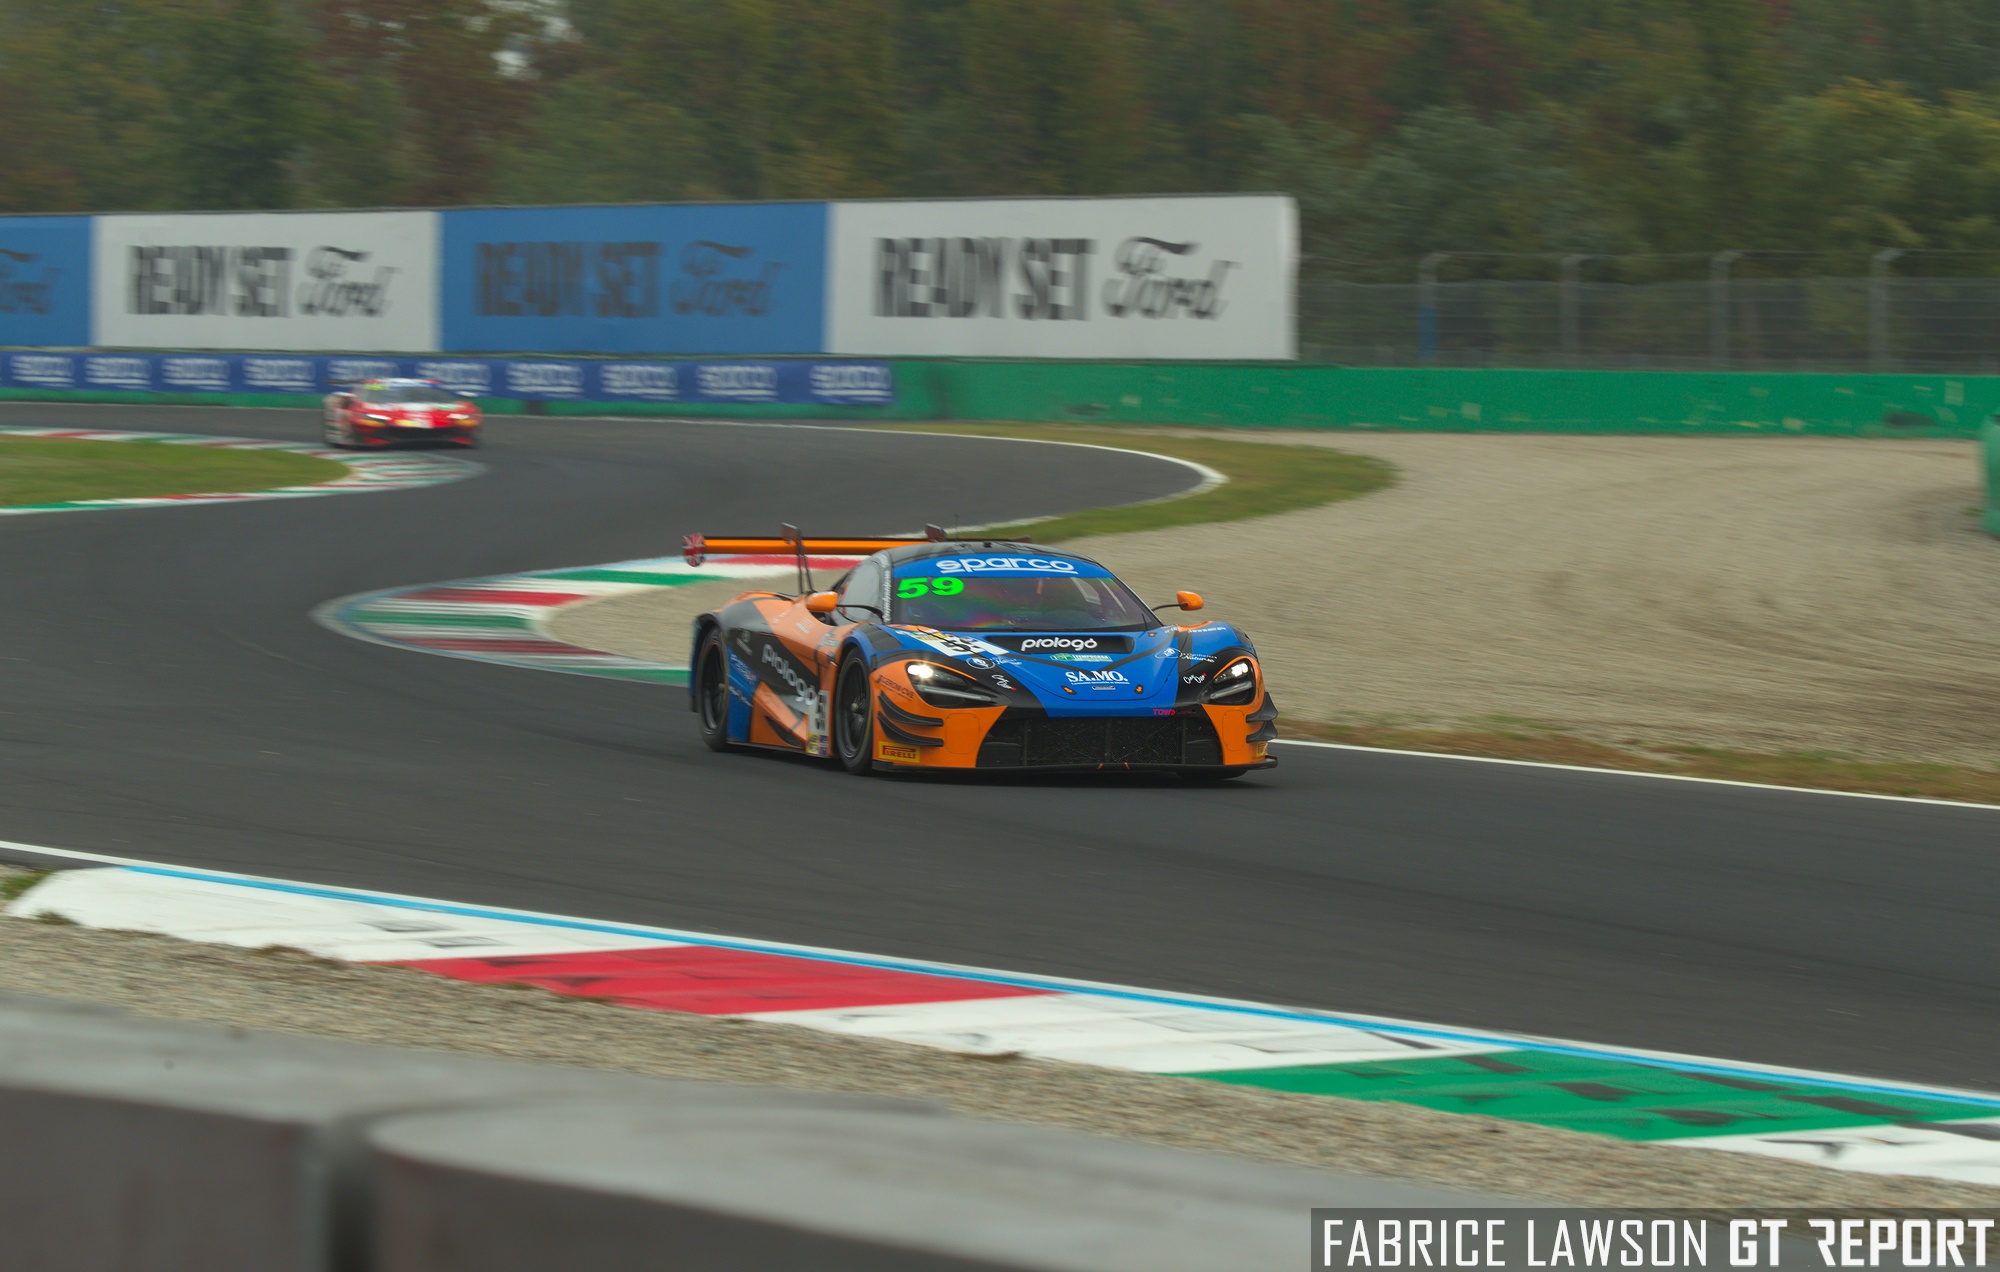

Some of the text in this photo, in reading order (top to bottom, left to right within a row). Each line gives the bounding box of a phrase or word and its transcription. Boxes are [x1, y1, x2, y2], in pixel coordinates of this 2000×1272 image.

[126, 245, 402, 318] READY SET Ford
[474, 239, 789, 318] READY SET Ford
[873, 236, 1243, 321] READY SET Ford
[936, 557, 1076, 573] sparco
[896, 576, 965, 599] 59
[1065, 671, 1128, 682] SA.MO.
[882, 745, 916, 759] PIRELLI
